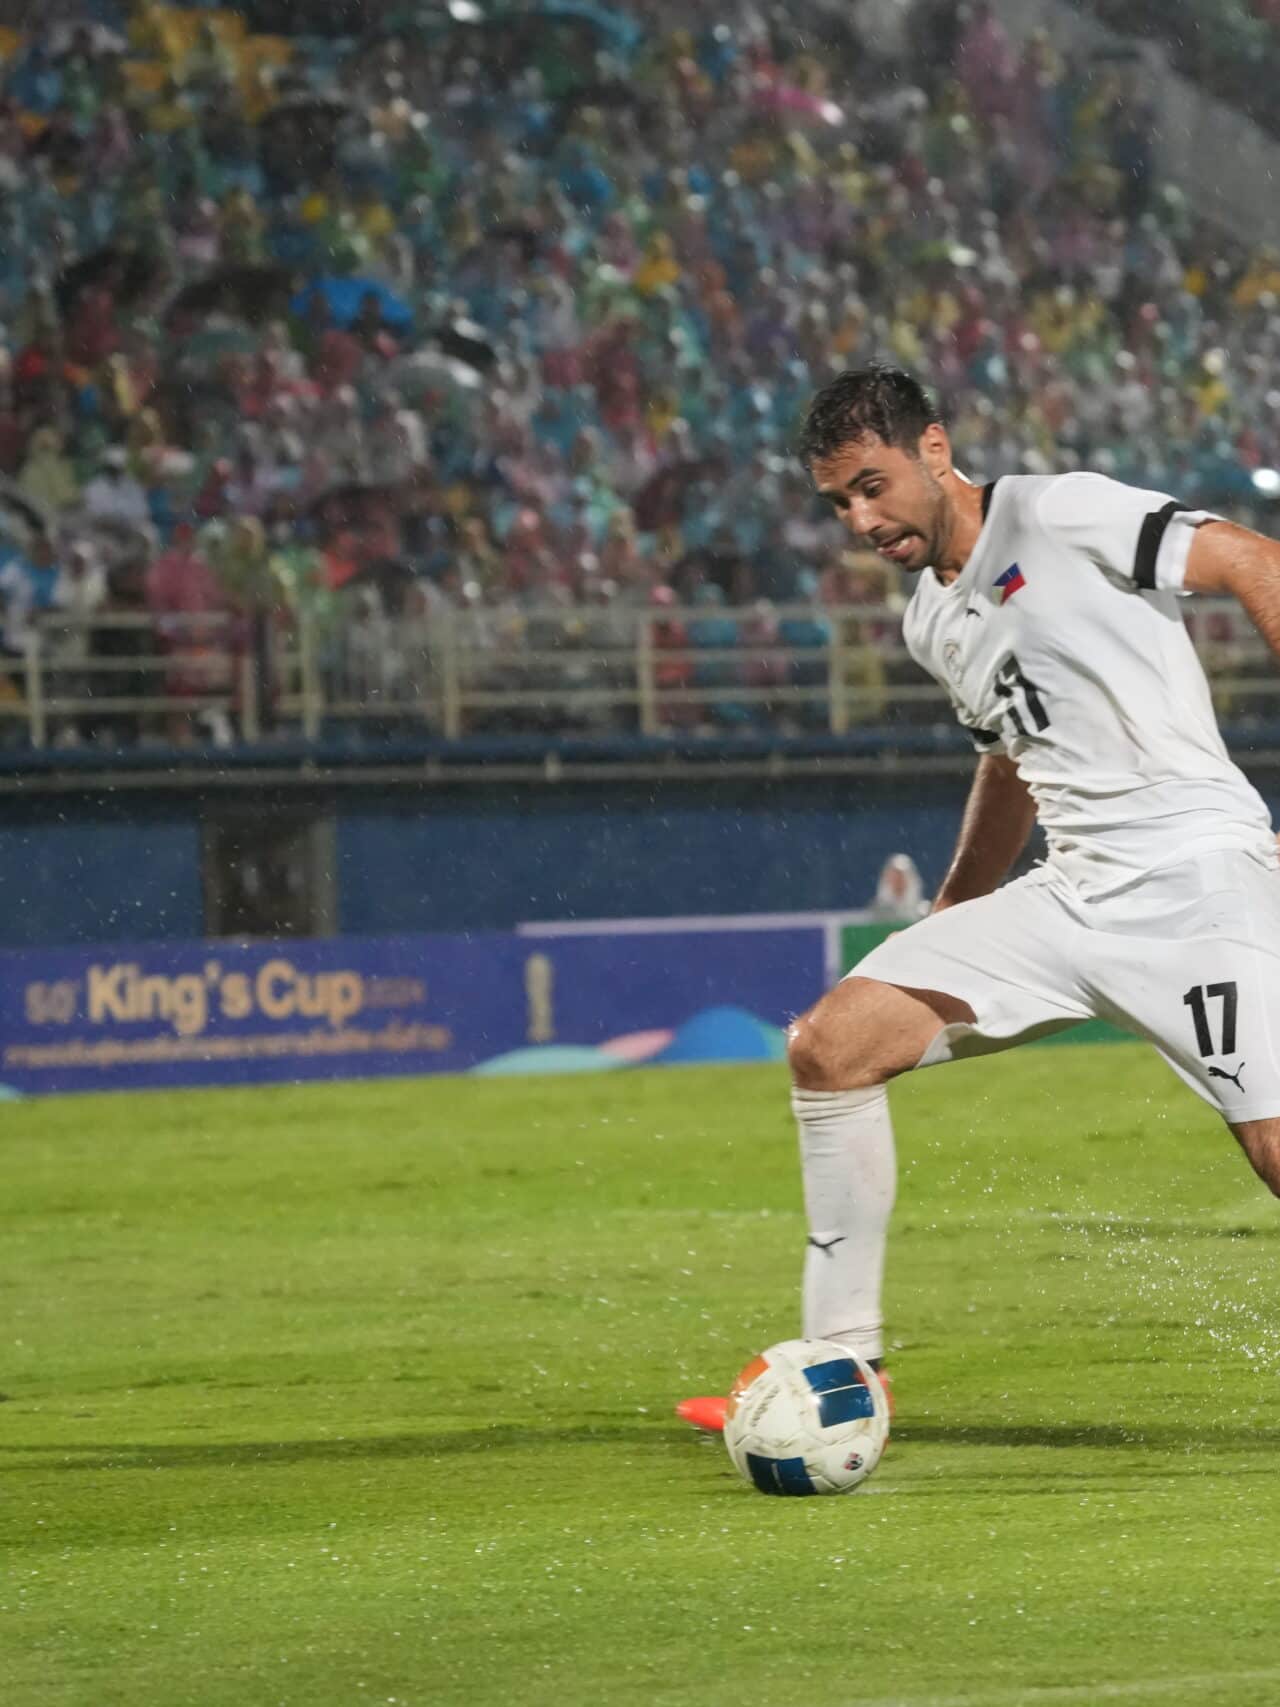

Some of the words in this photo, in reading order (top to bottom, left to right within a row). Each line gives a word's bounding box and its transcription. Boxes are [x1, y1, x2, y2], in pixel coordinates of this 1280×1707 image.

[87, 961, 251, 1033] King's
[257, 959, 362, 1025] Cup
[1184, 981, 1238, 1057] 17
